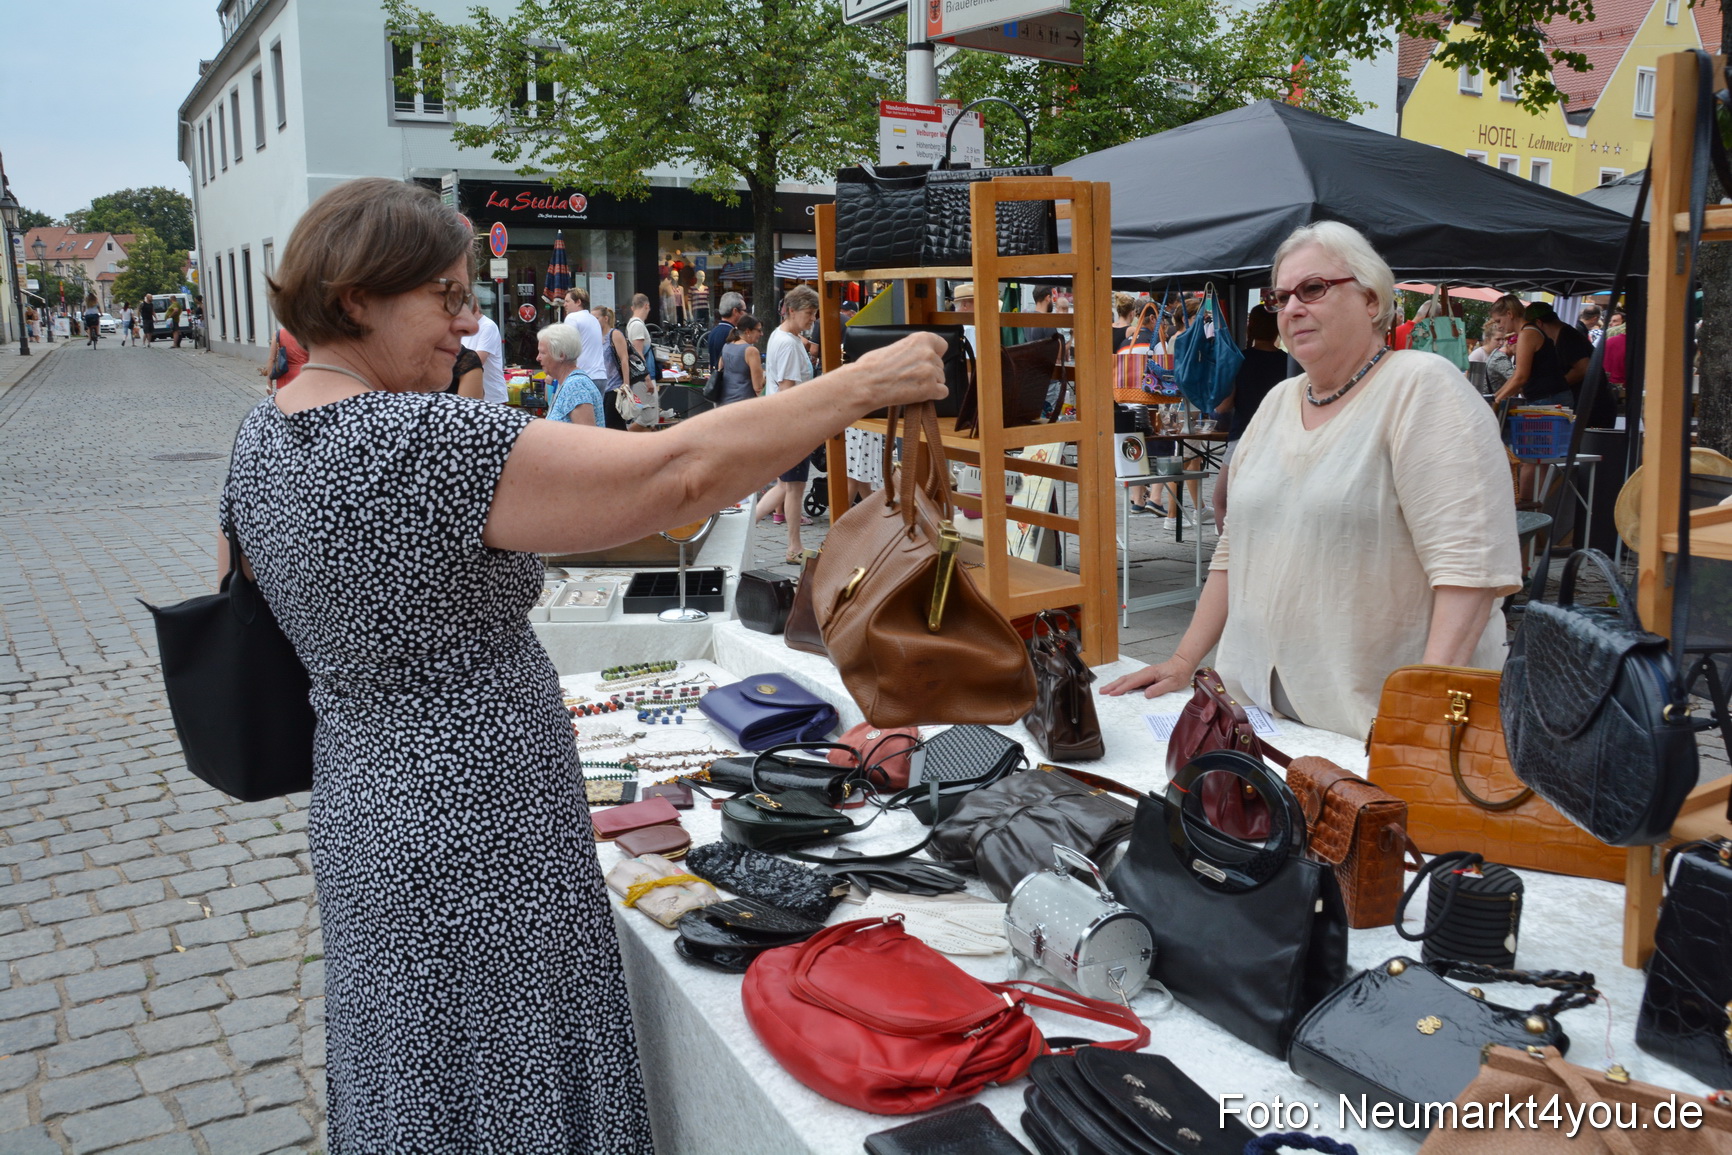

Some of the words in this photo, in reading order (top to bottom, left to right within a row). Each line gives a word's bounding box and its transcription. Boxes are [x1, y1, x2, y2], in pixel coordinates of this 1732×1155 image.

[1478, 124, 1518, 149] HOTEL
[1528, 133, 1573, 153] Lehmeier
[916, 142, 940, 151] Höhenberg
[916, 150, 933, 160] Velburg
[486, 190, 510, 207] La
[511, 191, 569, 211] Stella
